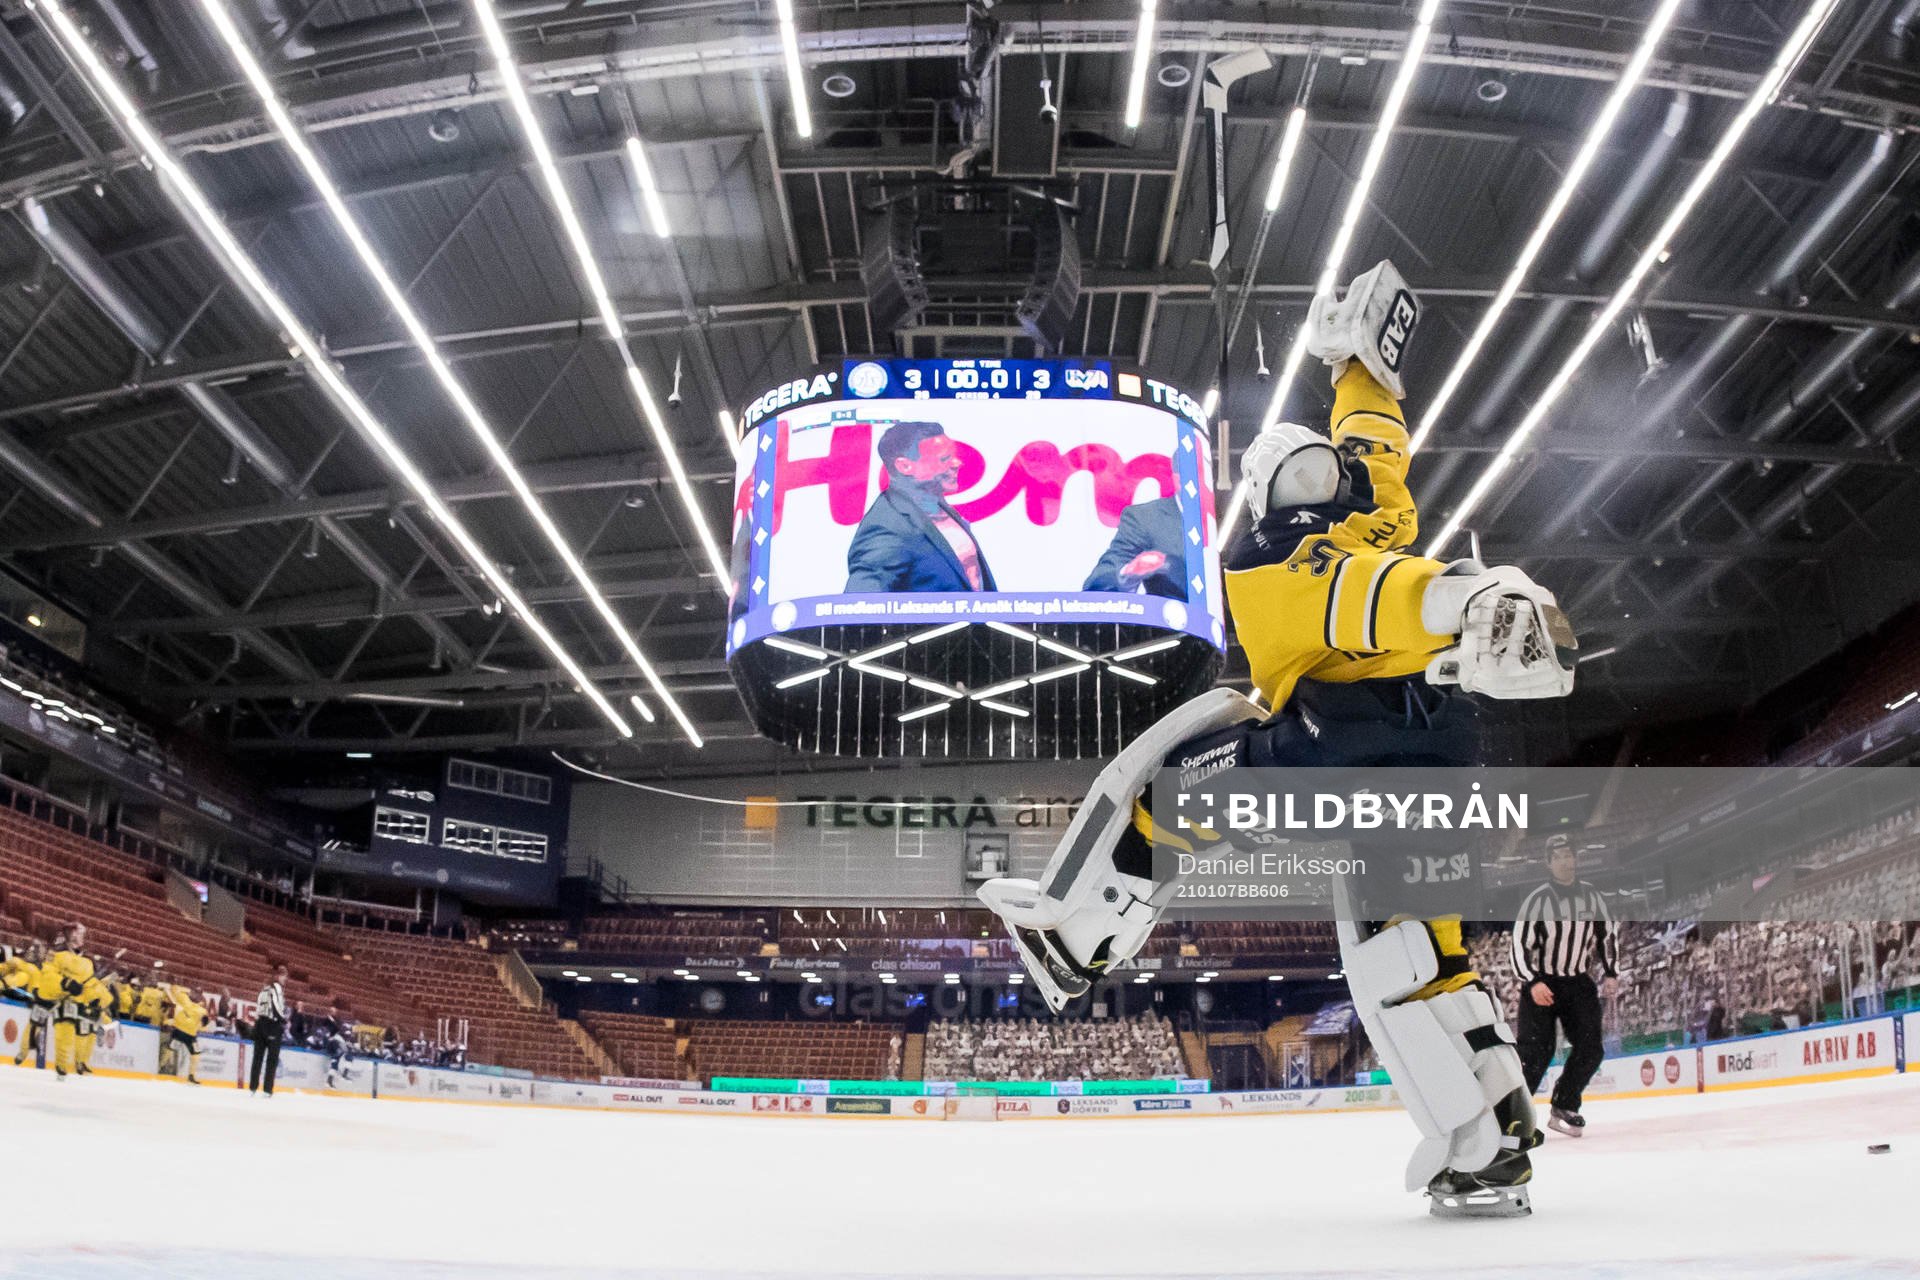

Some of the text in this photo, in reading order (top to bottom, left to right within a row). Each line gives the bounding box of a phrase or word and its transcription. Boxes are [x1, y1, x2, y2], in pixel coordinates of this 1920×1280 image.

[1381, 298, 1416, 368] EAB
[904, 369, 1051, 390] 3 00.0 3
[745, 374, 833, 429] TEGERA
[834, 600, 886, 615] medlem
[893, 600, 954, 615] Leksands
[1044, 598, 1062, 616] på
[1180, 740, 1239, 774] SHERWIN
[1180, 753, 1237, 791] WILLIAMS
[796, 795, 997, 828] TEGERA
[871, 959, 941, 970] clas ohlson
[1856, 1031, 1877, 1059] AB
[630, 1095, 644, 1103] ALL
[646, 1095, 663, 1103] OUT
[716, 1098, 735, 1106] OUT
[1242, 1092, 1302, 1103] LEKSANDS
